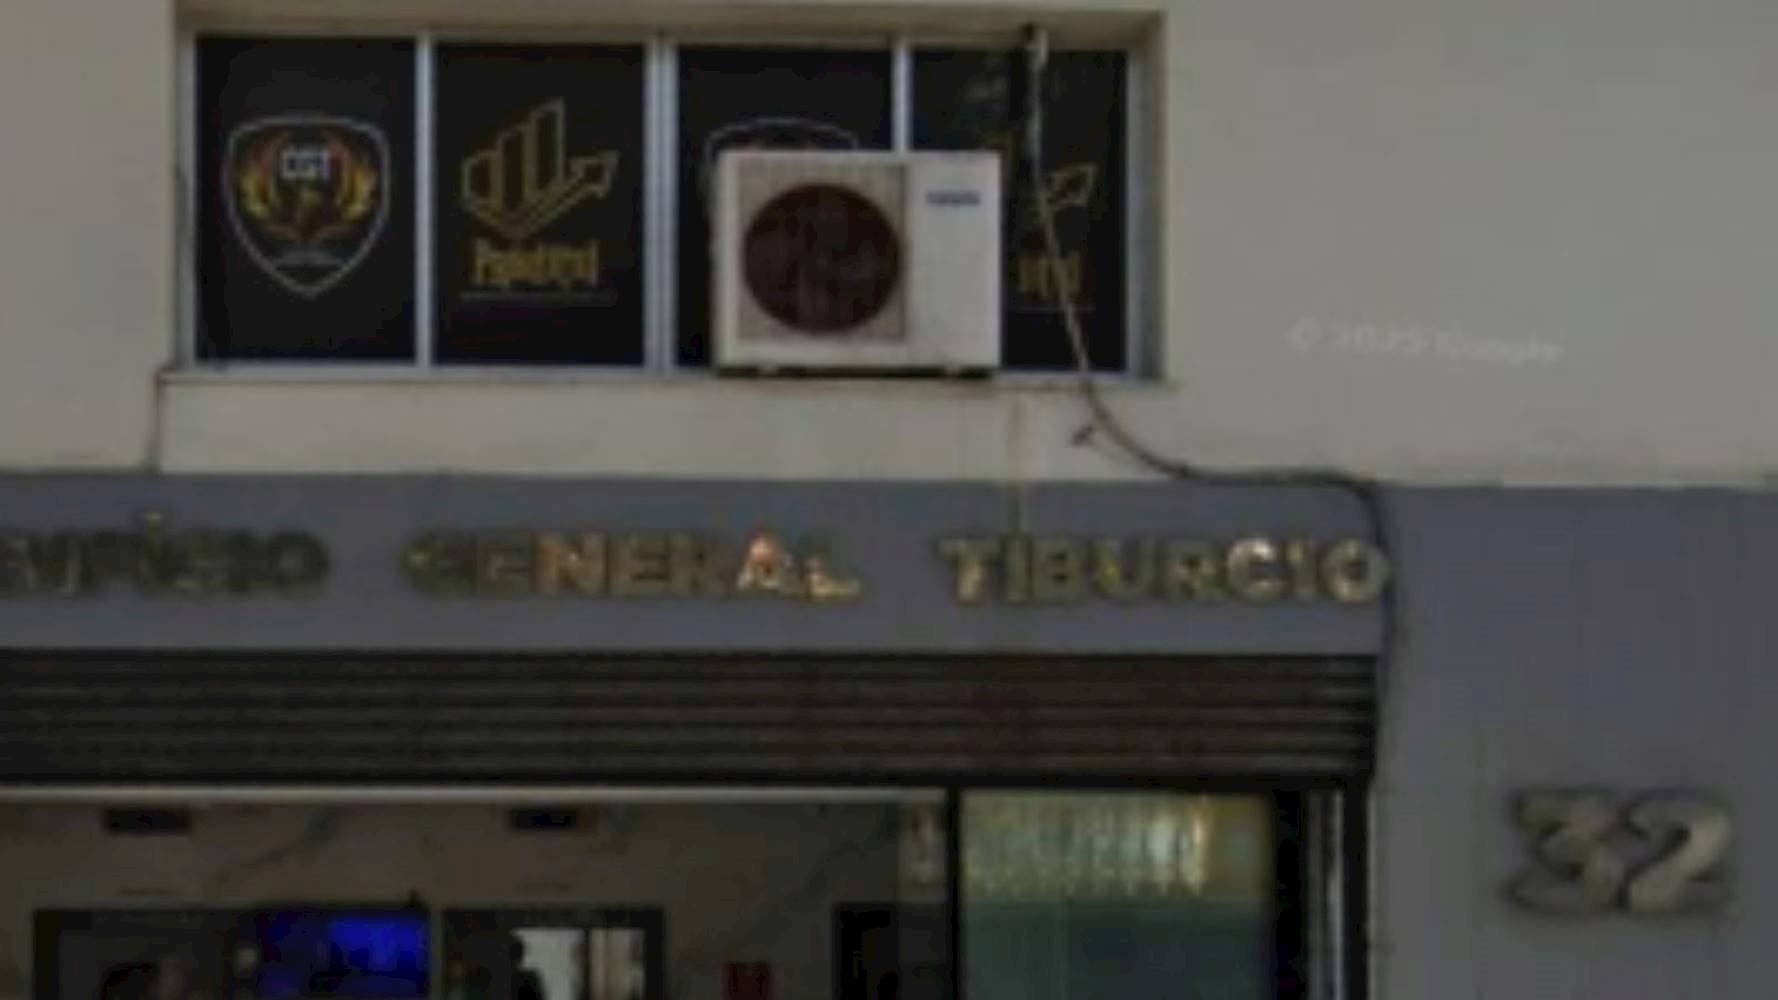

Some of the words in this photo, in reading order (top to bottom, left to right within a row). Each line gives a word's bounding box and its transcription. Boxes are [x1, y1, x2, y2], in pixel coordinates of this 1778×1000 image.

[402, 528, 864, 602] GENERAL
[936, 532, 1388, 604] TIBURCIO
[1500, 786, 1736, 922] 32
